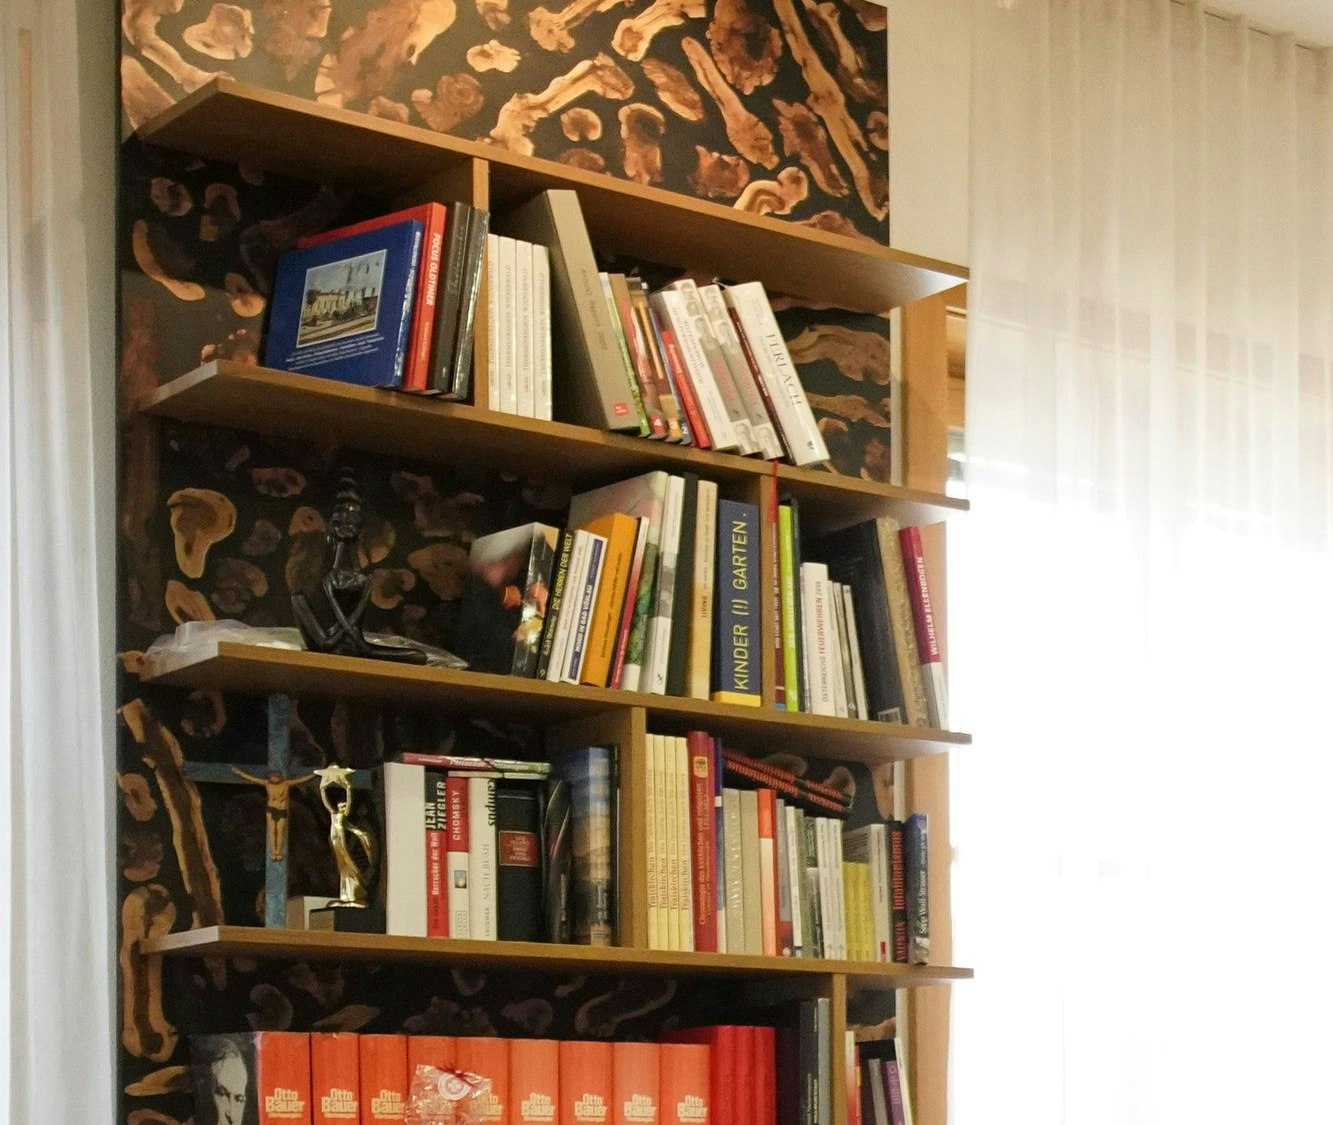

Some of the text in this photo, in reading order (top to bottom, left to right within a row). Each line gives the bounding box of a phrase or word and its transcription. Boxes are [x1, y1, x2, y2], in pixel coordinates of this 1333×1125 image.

[429, 233, 441, 267] FOCUS
[554, 568, 566, 597] HERREN
[564, 533, 573, 553] WELT
[916, 556, 938, 656] WILHELM ELLENBOGEN
[815, 597, 826, 655] FEUERWEHREN
[733, 625, 749, 690] KINDER
[437, 781, 447, 830] ZIEGLER
[425, 802, 437, 829] JEAN
[452, 790, 461, 841] CHOMSKY
[670, 858, 678, 910] Traiskirchen
[274, 1088, 298, 1100] Otto
[330, 1088, 353, 1100] Otto
[380, 1089, 400, 1101] Otto
[529, 1092, 550, 1105] Otto
[583, 1093, 603, 1105] Otto
[631, 1093, 652, 1105] Otto
[685, 1095, 704, 1107] Otto
[265, 1096, 304, 1113] Bauer
[321, 1097, 358, 1113] Bauer
[521, 1101, 555, 1116] Bauer
[574, 1101, 607, 1117] Bauer
[623, 1102, 657, 1117] Bauer
[677, 1102, 708, 1118] Bauer
